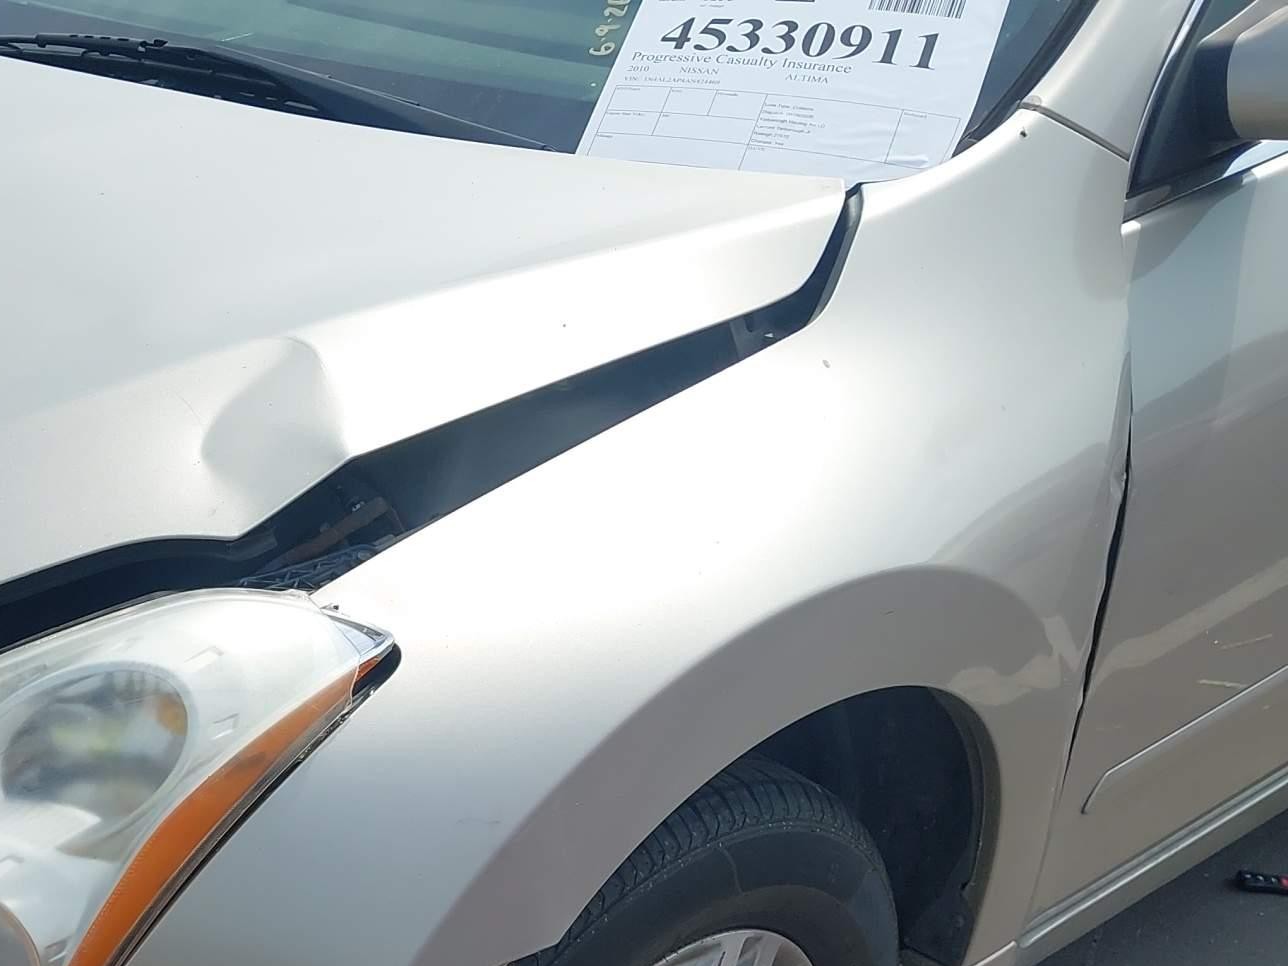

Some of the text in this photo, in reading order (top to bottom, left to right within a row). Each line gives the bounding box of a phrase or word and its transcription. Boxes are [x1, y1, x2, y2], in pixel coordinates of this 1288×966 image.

[660, 16, 940, 71] 45330911
[631, 51, 853, 74] Progressive Casualty Insurance
[625, 65, 829, 85] 2010 NISSAN ALTIMA
